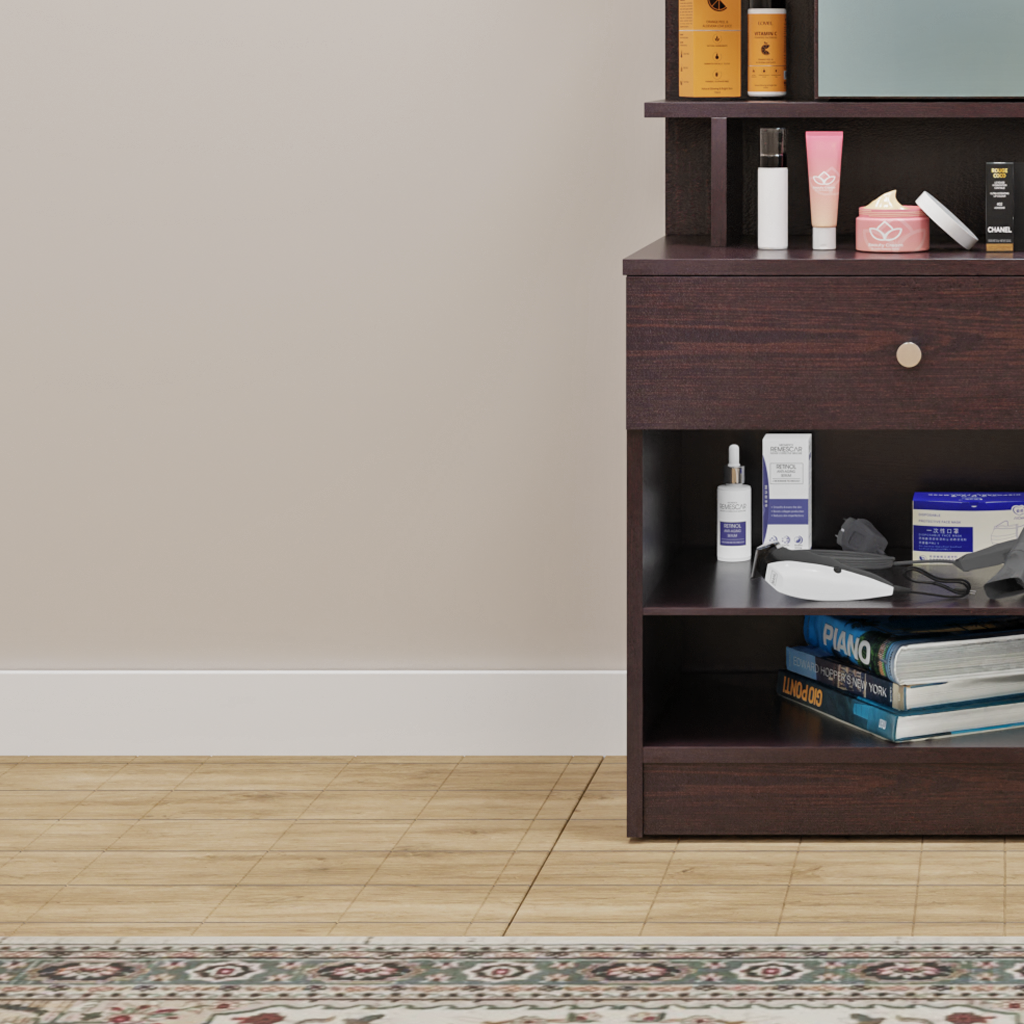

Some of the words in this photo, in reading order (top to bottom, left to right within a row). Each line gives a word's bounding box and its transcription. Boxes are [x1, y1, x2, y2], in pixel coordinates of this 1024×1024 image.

[822, 623, 871, 665] PIANO
[782, 676, 809, 702] PONTI
[792, 656, 819, 673] EDWARD
[852, 677, 867, 690] NEW
[868, 682, 888, 698] YORK
[808, 685, 823, 708] GIO
